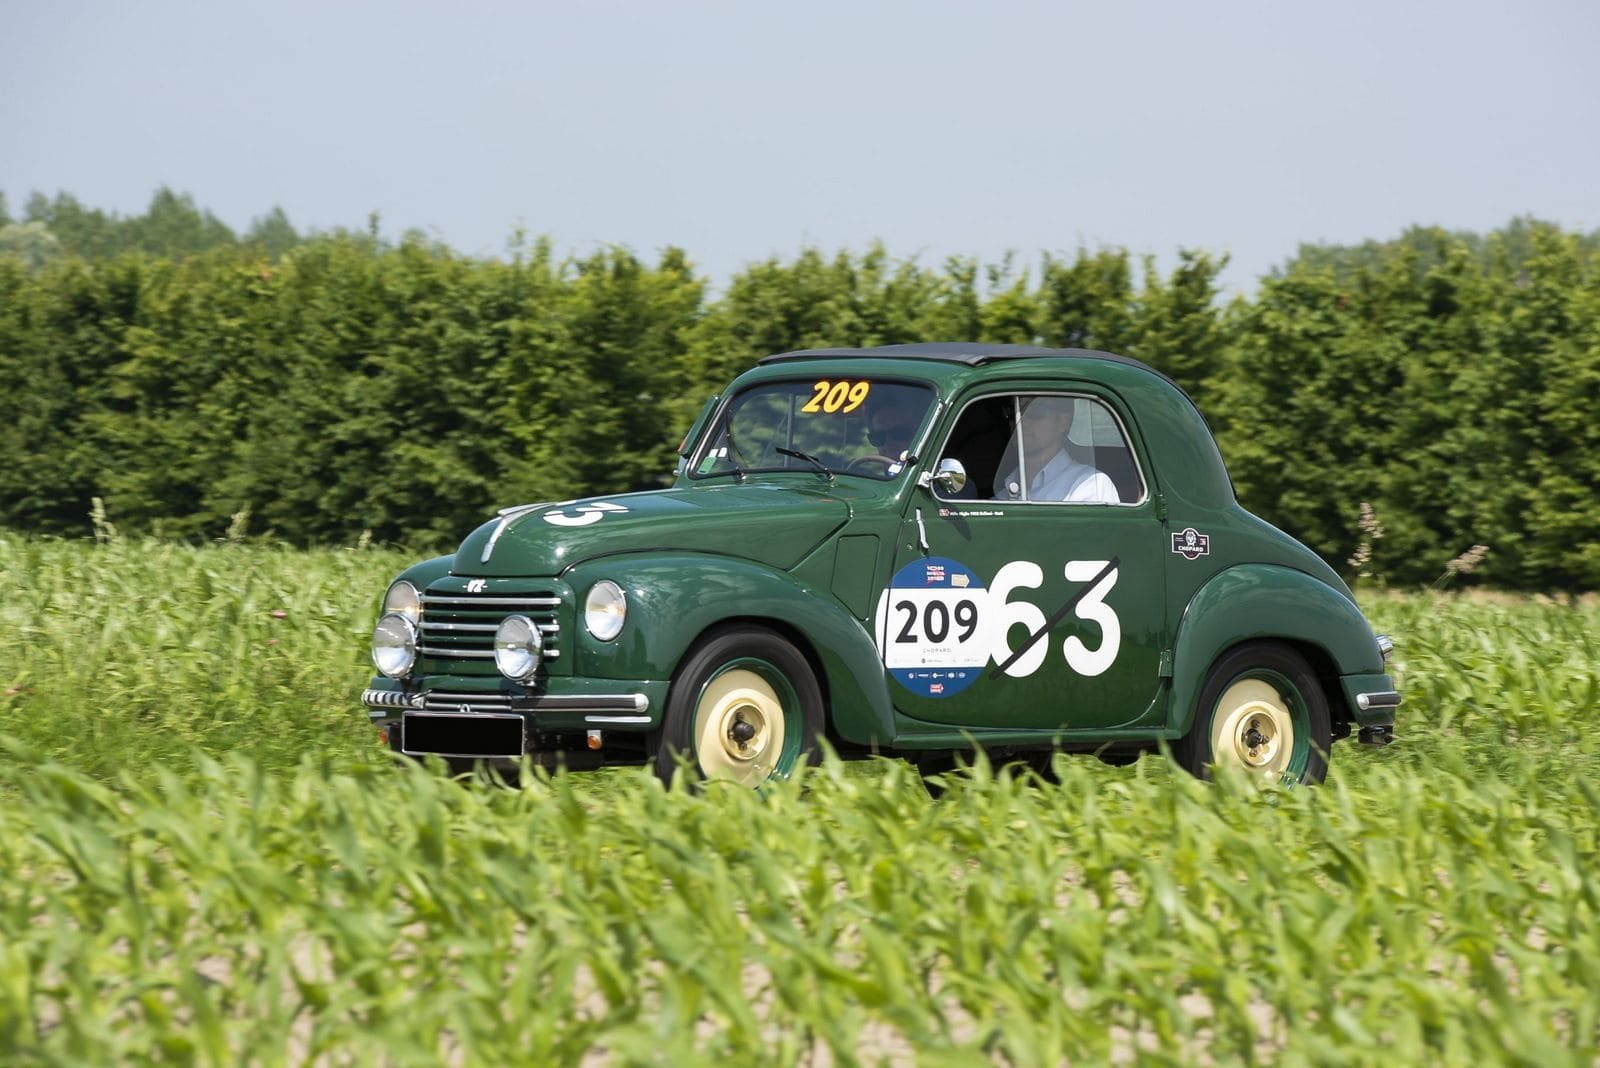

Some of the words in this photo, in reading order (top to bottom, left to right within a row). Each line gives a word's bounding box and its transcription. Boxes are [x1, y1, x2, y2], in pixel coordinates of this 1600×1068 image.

[801, 381, 869, 414] 209
[895, 599, 978, 644] 209
[989, 560, 1121, 678] 63
